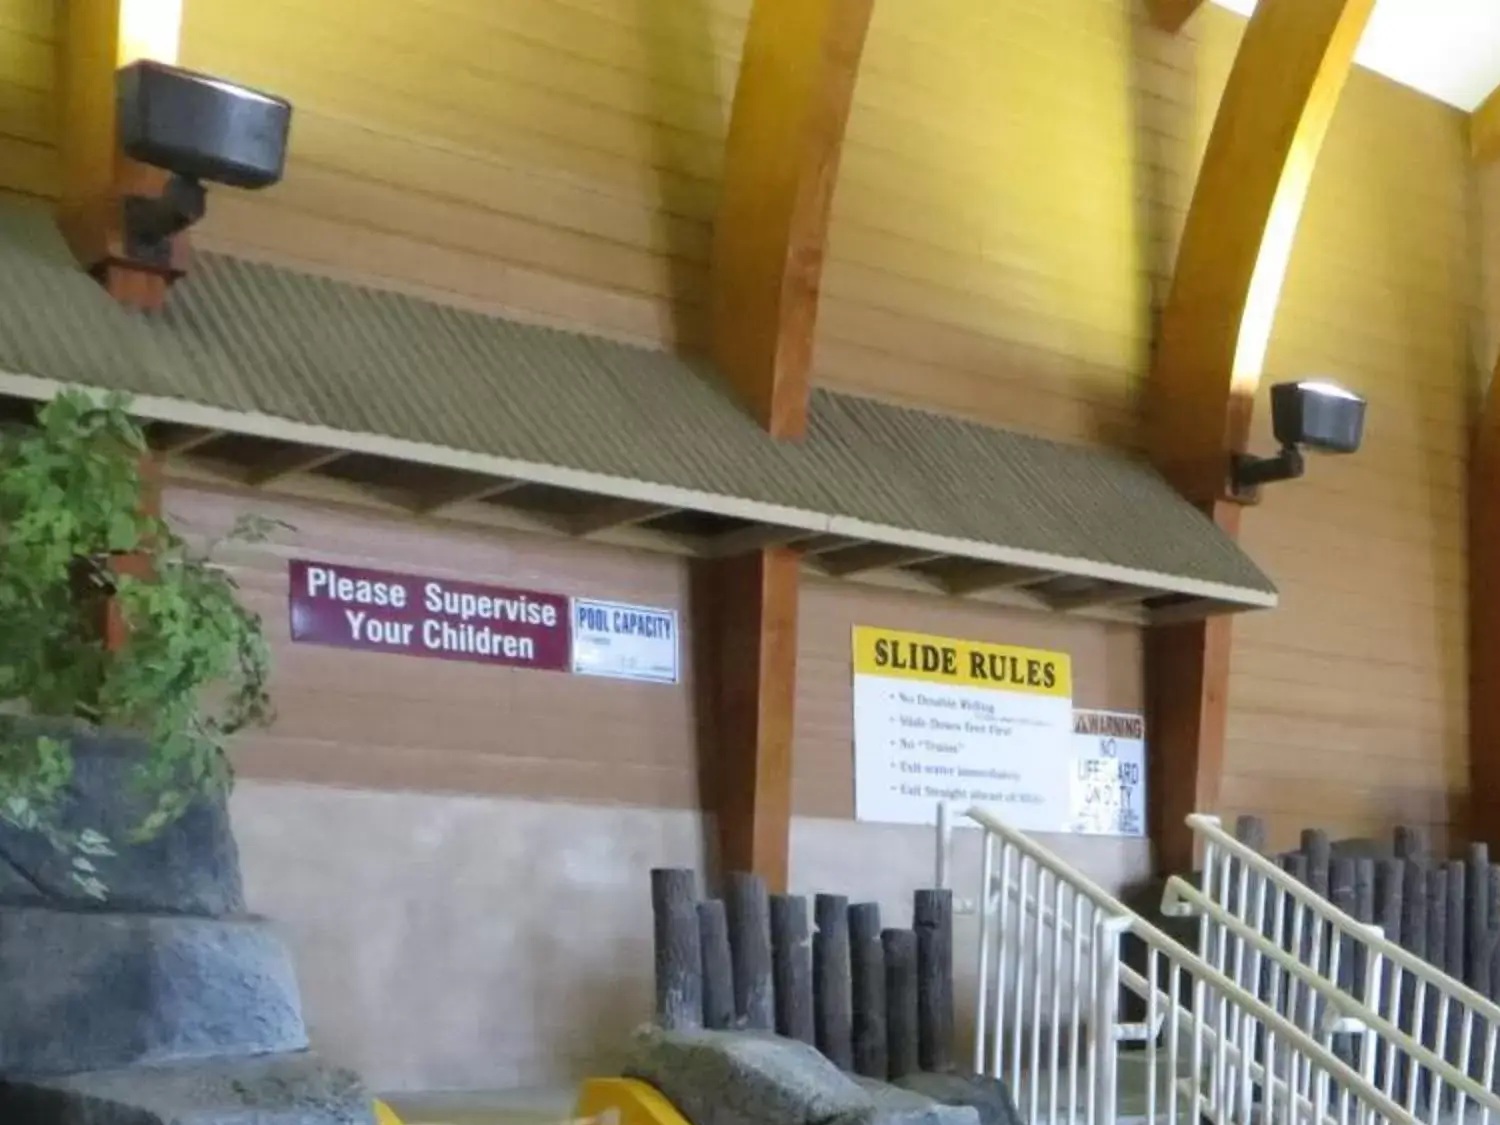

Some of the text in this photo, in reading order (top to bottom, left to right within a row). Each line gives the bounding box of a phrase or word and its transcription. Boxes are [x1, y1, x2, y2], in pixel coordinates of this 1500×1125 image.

[306, 566, 558, 626] Please Supervise
[345, 609, 534, 660] Your Children
[579, 606, 671, 641] POOL CAPACITY
[874, 637, 1057, 689] SLIDE RULES
[1088, 714, 1142, 739] WARNING
